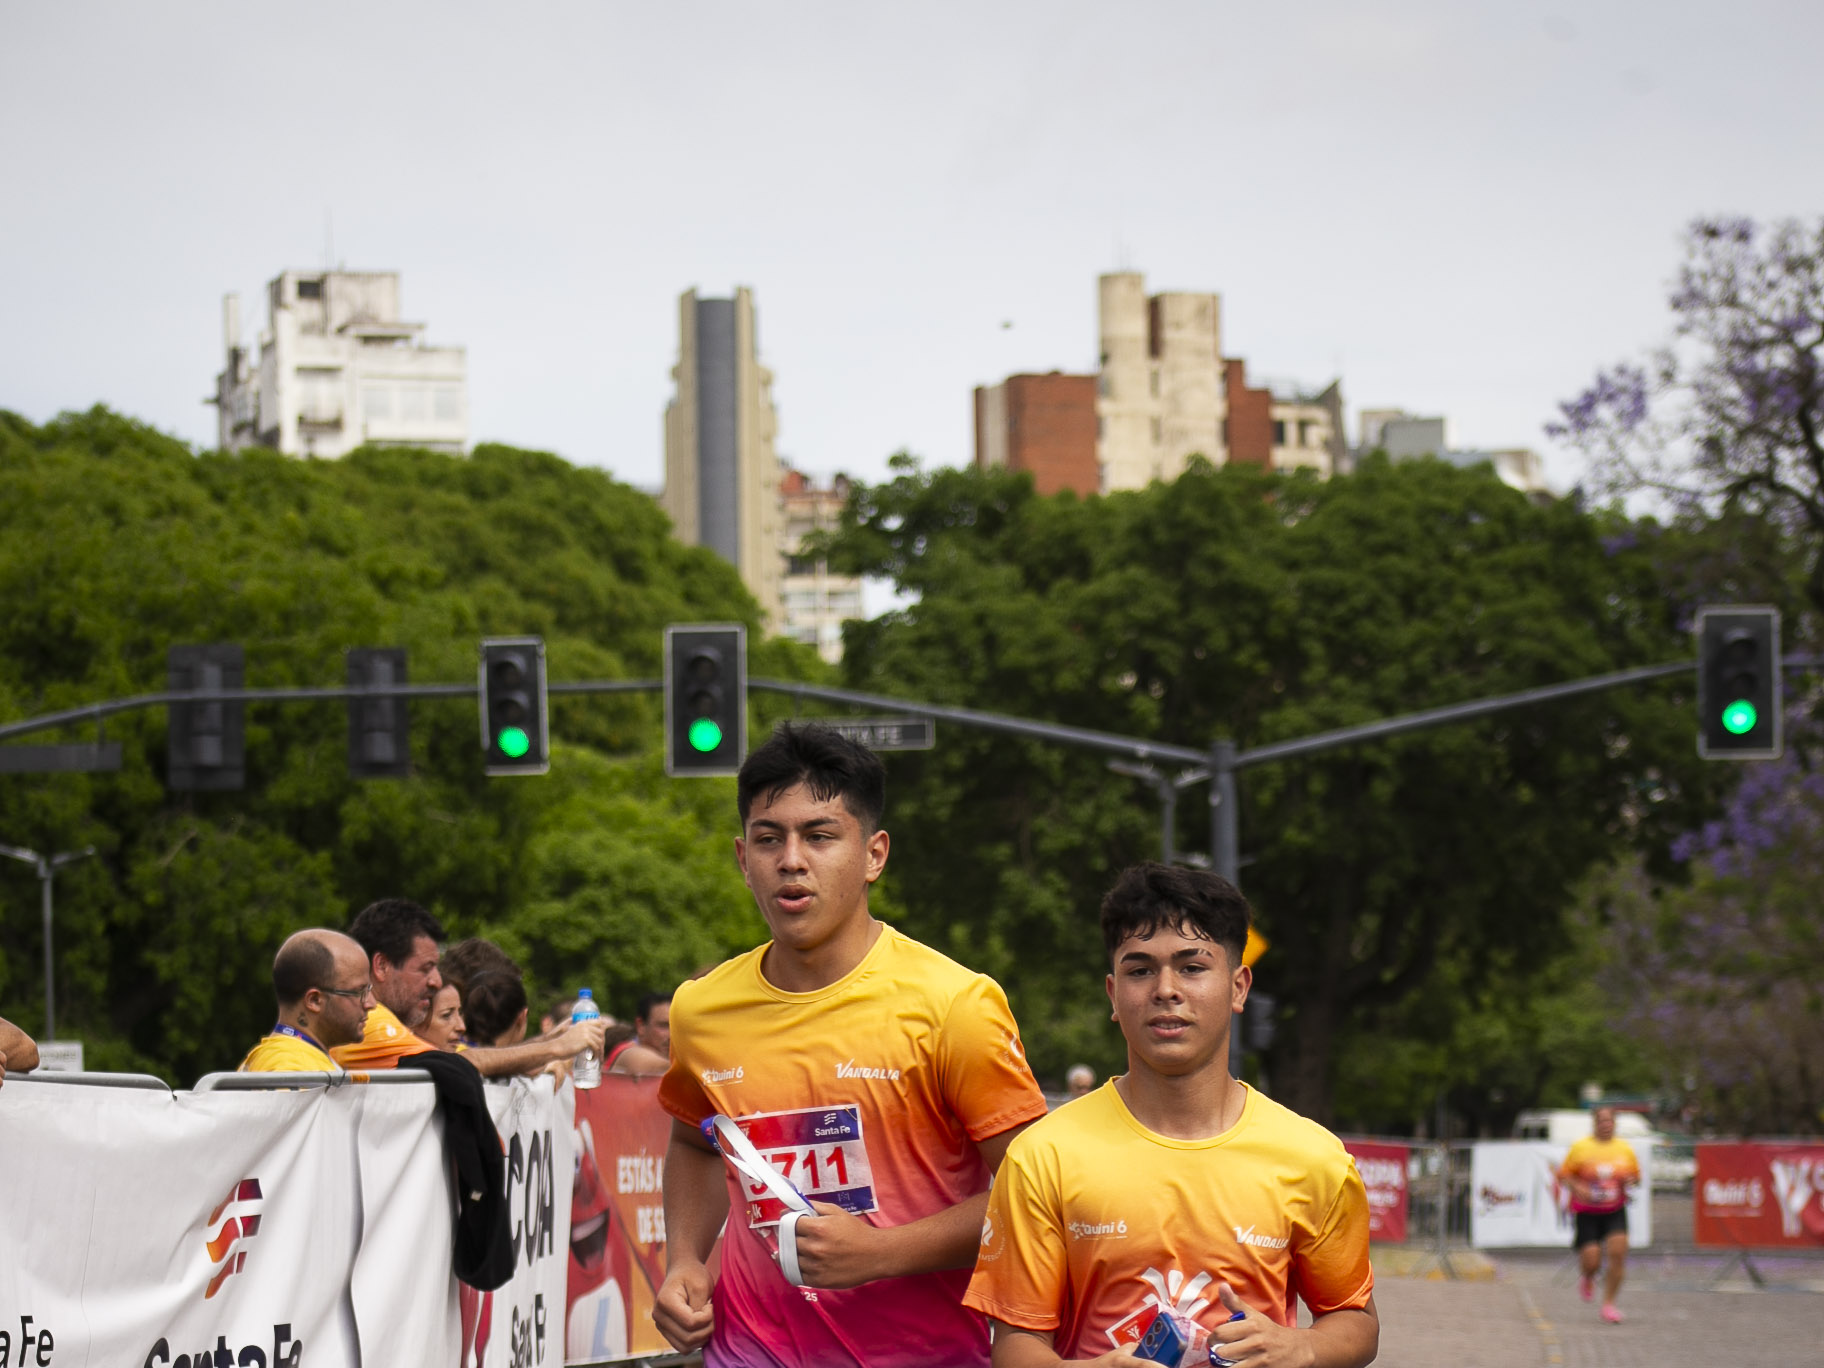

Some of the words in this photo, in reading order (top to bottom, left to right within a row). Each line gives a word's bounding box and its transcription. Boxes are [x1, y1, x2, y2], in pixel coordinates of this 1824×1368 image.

[736, 1066, 744, 1079] 6
[834, 1058, 900, 1081] VANDALIA
[815, 1127, 839, 1137] Santa
[840, 1125, 851, 1134] Fe
[1117, 1220, 1128, 1234] 6
[1232, 1224, 1289, 1249] VANDALIA
[18, 1315, 54, 1368] Fe
